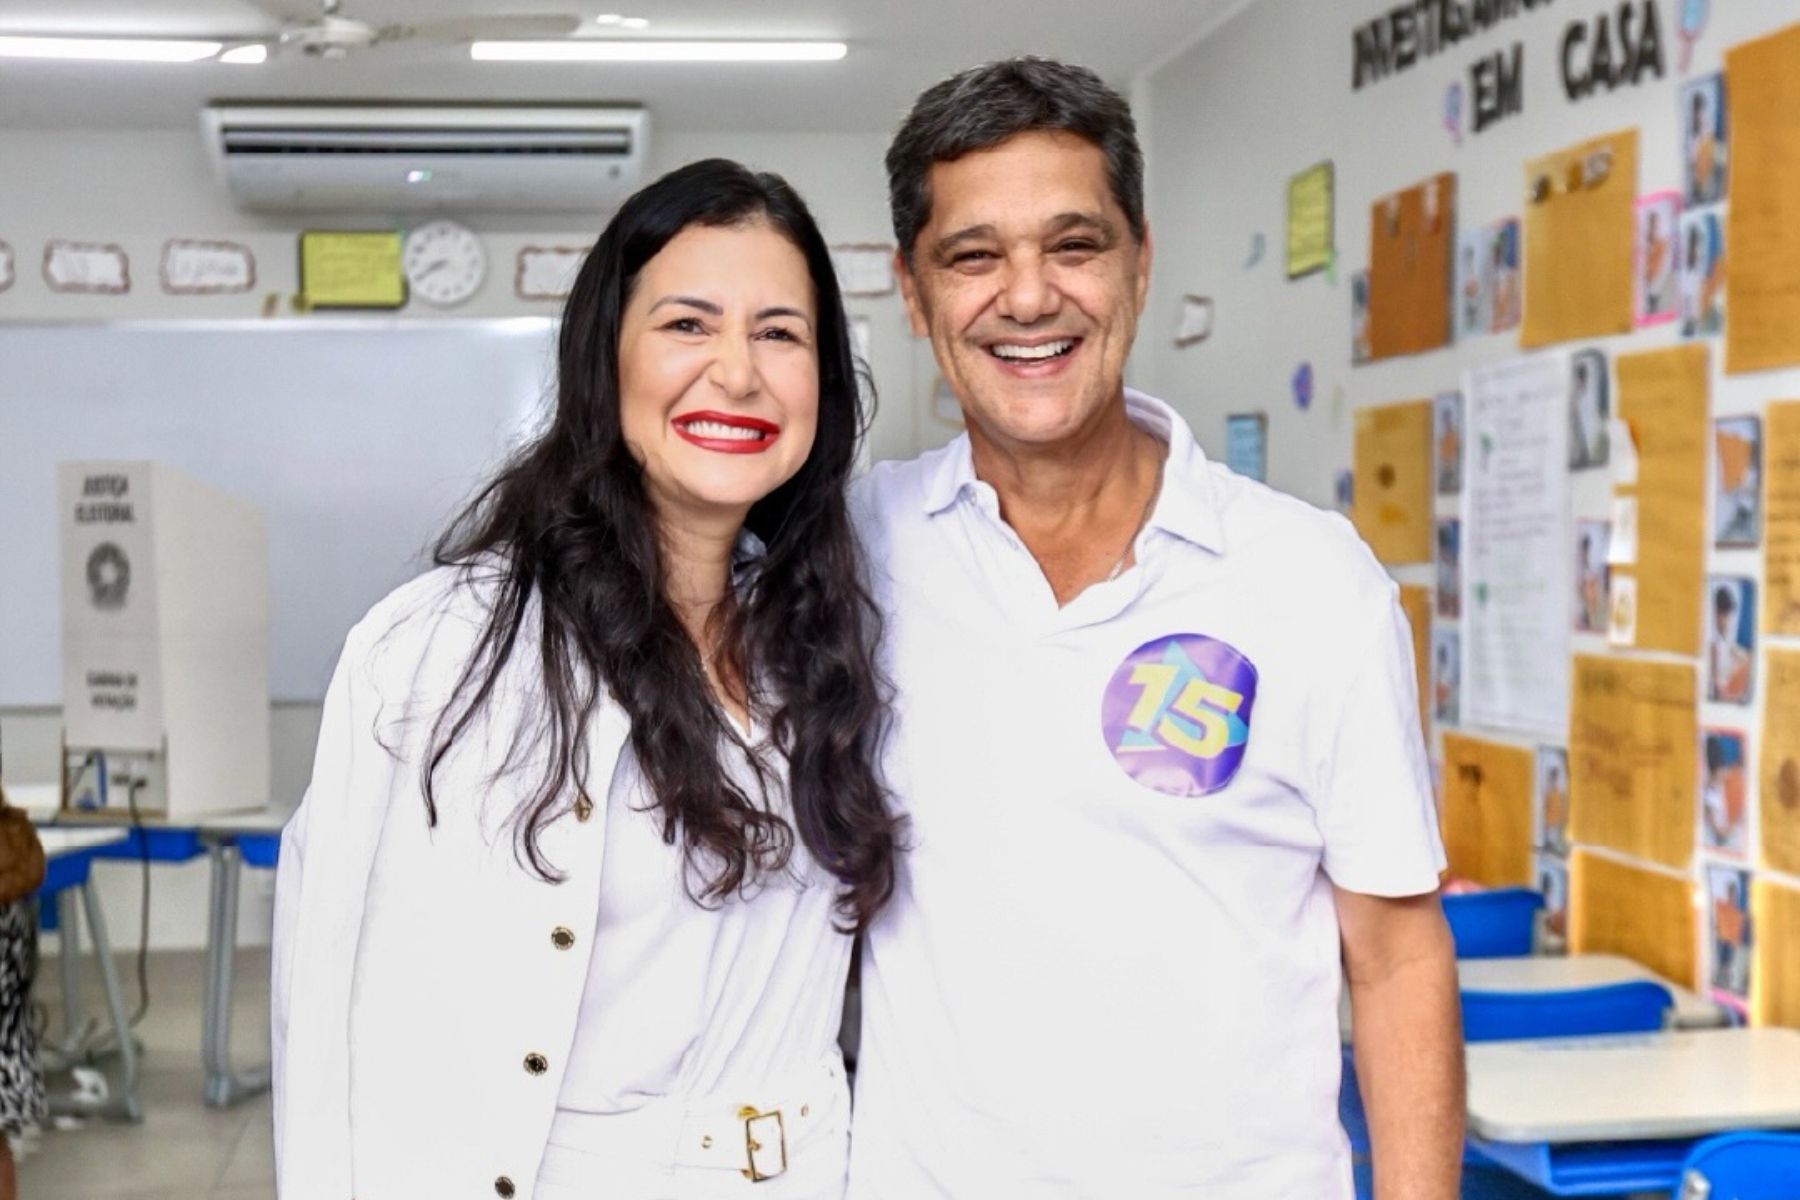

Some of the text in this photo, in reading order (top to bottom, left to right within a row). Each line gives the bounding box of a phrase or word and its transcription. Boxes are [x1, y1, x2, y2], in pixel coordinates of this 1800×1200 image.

[1470, 0, 1665, 132] EM CASA
[1125, 662, 1243, 759] 15
